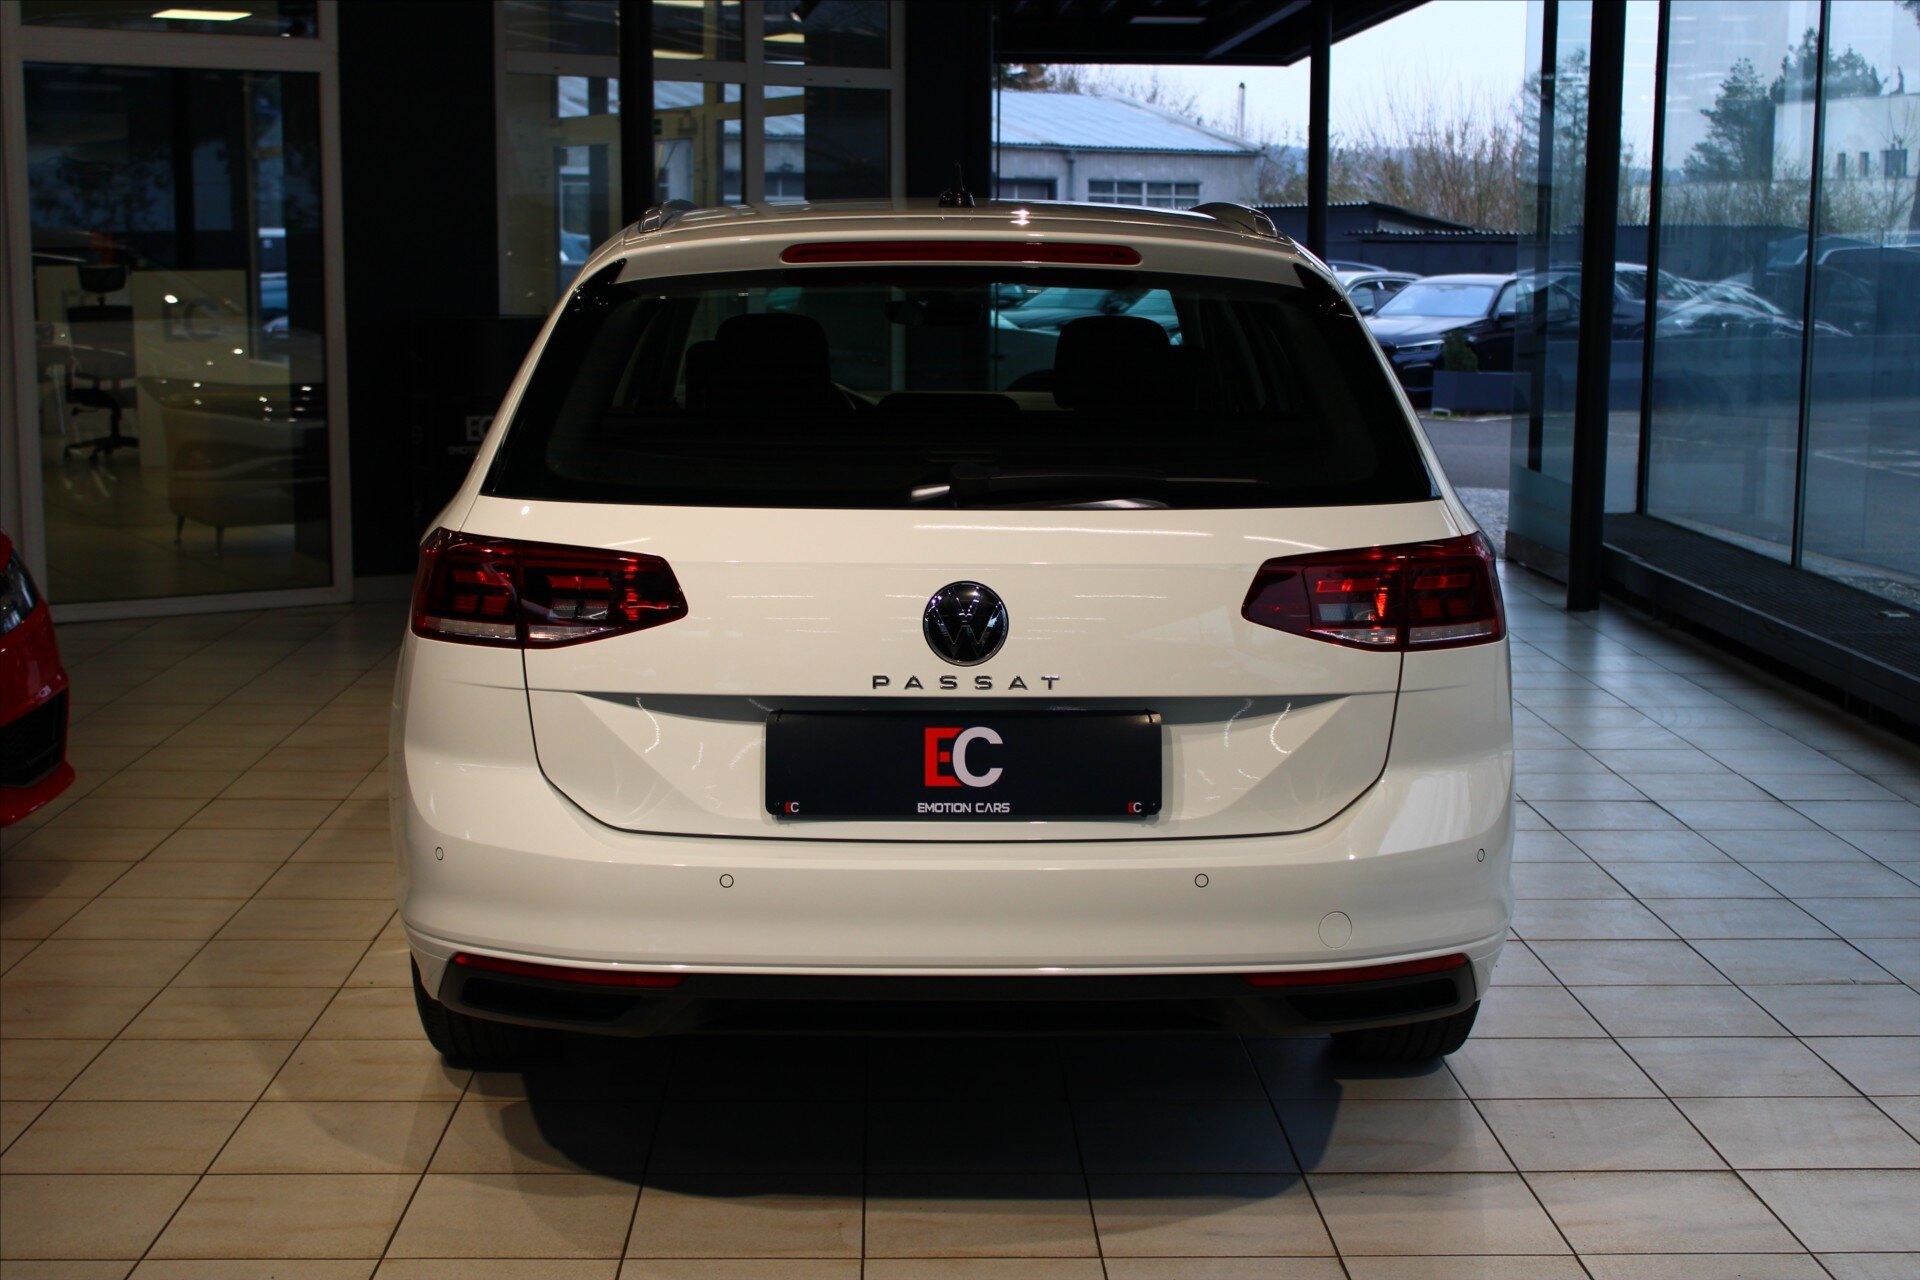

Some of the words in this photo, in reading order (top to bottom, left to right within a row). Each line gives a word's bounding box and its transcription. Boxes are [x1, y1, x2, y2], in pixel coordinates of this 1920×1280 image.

[872, 675, 1060, 690] PASSAT
[924, 726, 1004, 788] EC
[785, 801, 800, 814] EC
[917, 802, 972, 814] EMOTION
[975, 802, 1011, 814] CARS
[1128, 801, 1143, 814] EC
